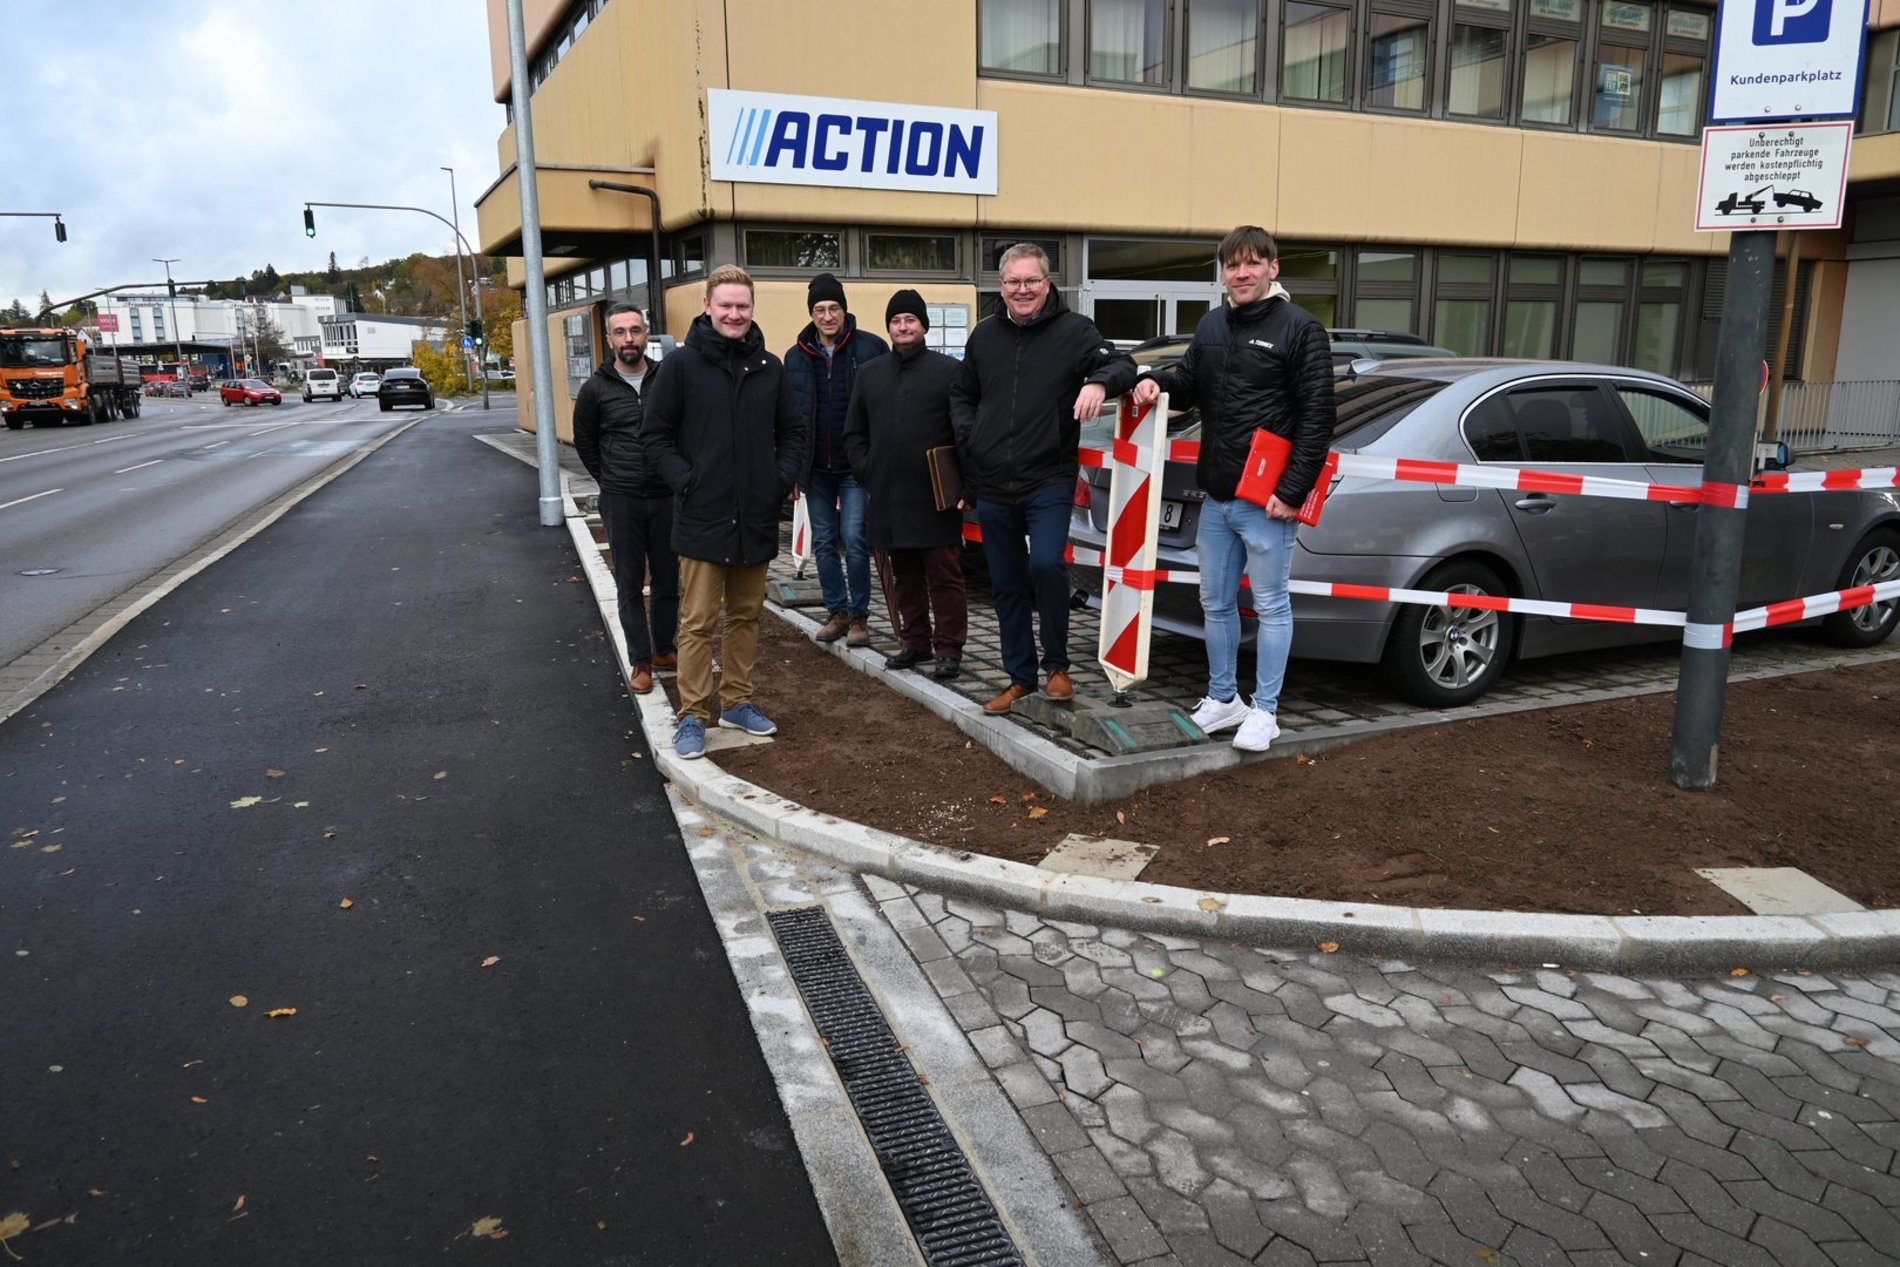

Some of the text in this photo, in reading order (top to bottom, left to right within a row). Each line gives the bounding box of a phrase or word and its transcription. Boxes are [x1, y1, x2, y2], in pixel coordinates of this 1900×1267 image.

[1771, 0, 1818, 36] P
[1730, 70, 1842, 86] Kundenparkplatz
[764, 110, 985, 179] ACTION
[1749, 137, 1804, 148] Unberechtigt
[1731, 148, 1819, 161] parkende Fahrzeuge
[1725, 159, 1823, 171] werden kostenpflichtig
[1744, 171, 1801, 182] abgeschleppt
[1164, 504, 1173, 523] 8
